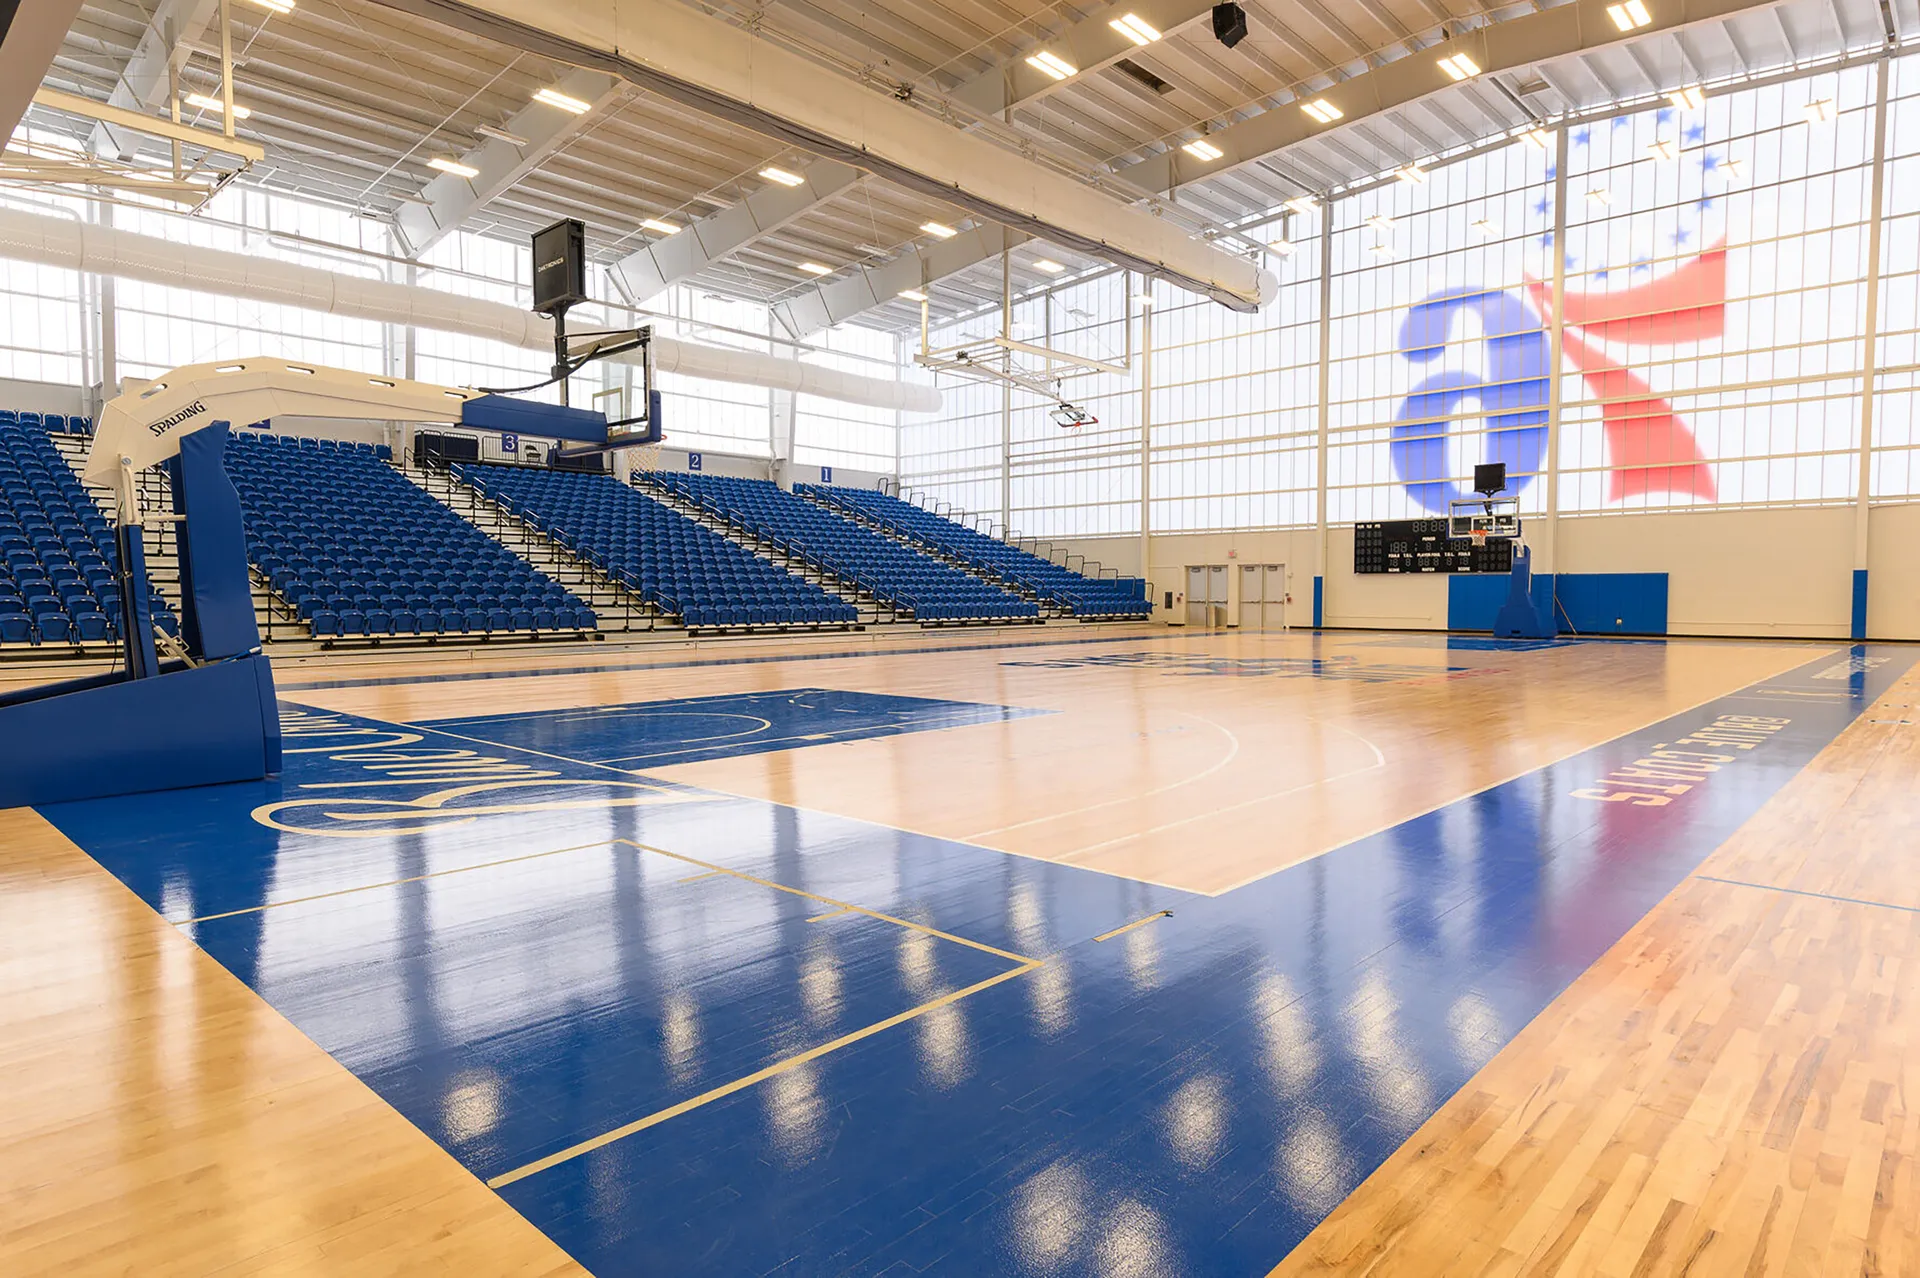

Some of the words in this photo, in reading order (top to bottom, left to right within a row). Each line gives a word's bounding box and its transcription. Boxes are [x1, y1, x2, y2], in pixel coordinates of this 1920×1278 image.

[149, 400, 206, 437] SPALDING
[505, 435, 515, 450] 3
[691, 455, 699, 468] 2
[823, 468, 830, 481] 1
[251, 748, 741, 837] Blue
